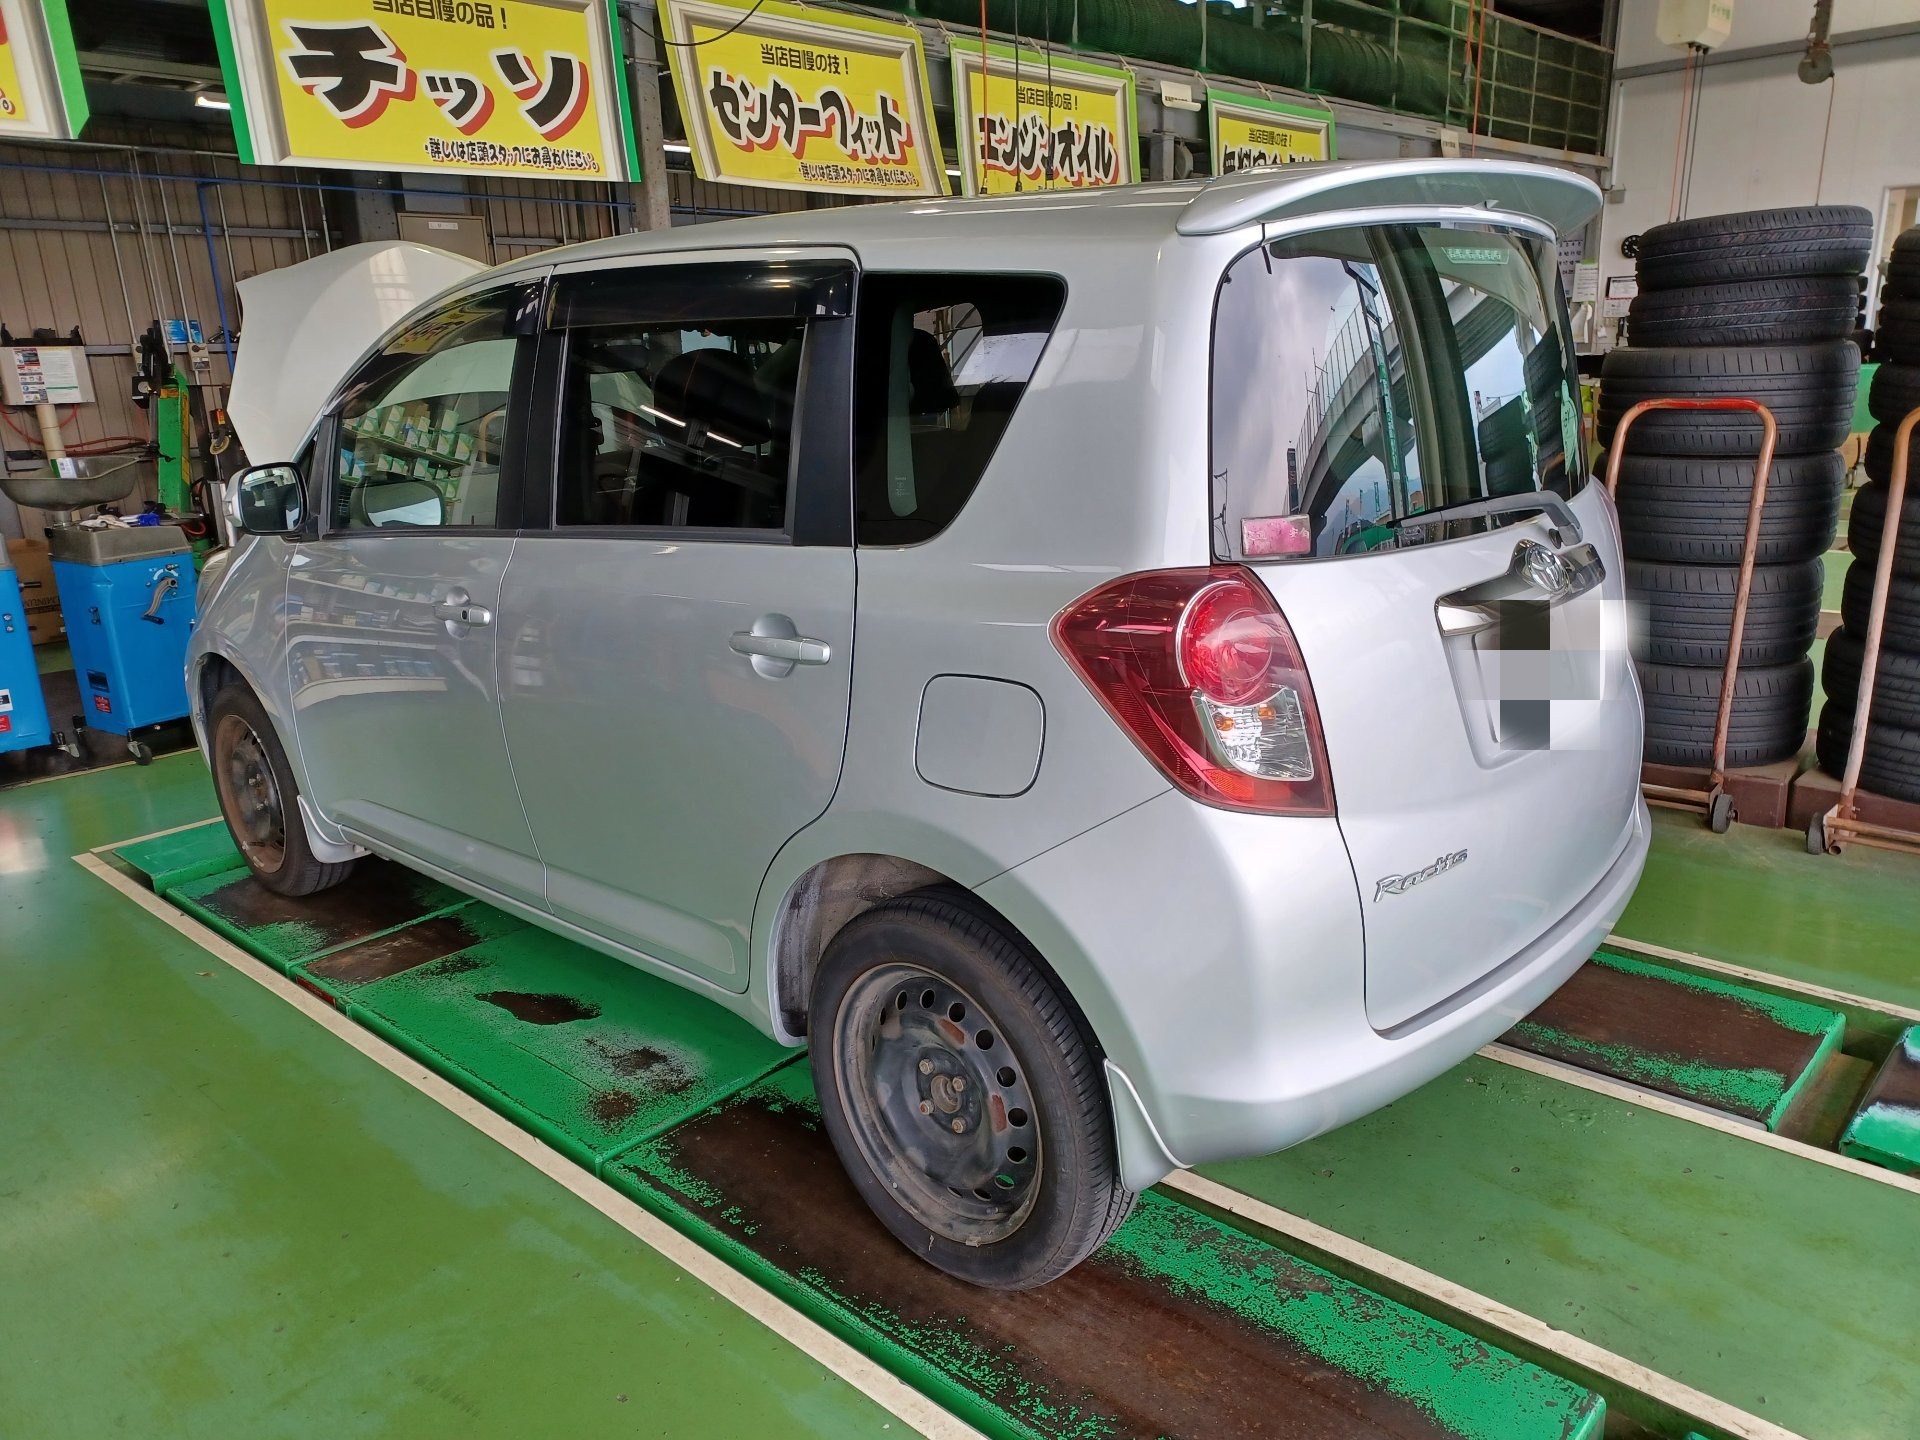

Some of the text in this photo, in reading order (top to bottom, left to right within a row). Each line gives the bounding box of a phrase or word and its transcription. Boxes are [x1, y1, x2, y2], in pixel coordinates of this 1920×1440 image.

[285, 23, 582, 134] チッソ
[708, 69, 908, 158] センターフィット
[977, 113, 1115, 182] エンジンオイル
[1373, 848, 1468, 903] Ractis
